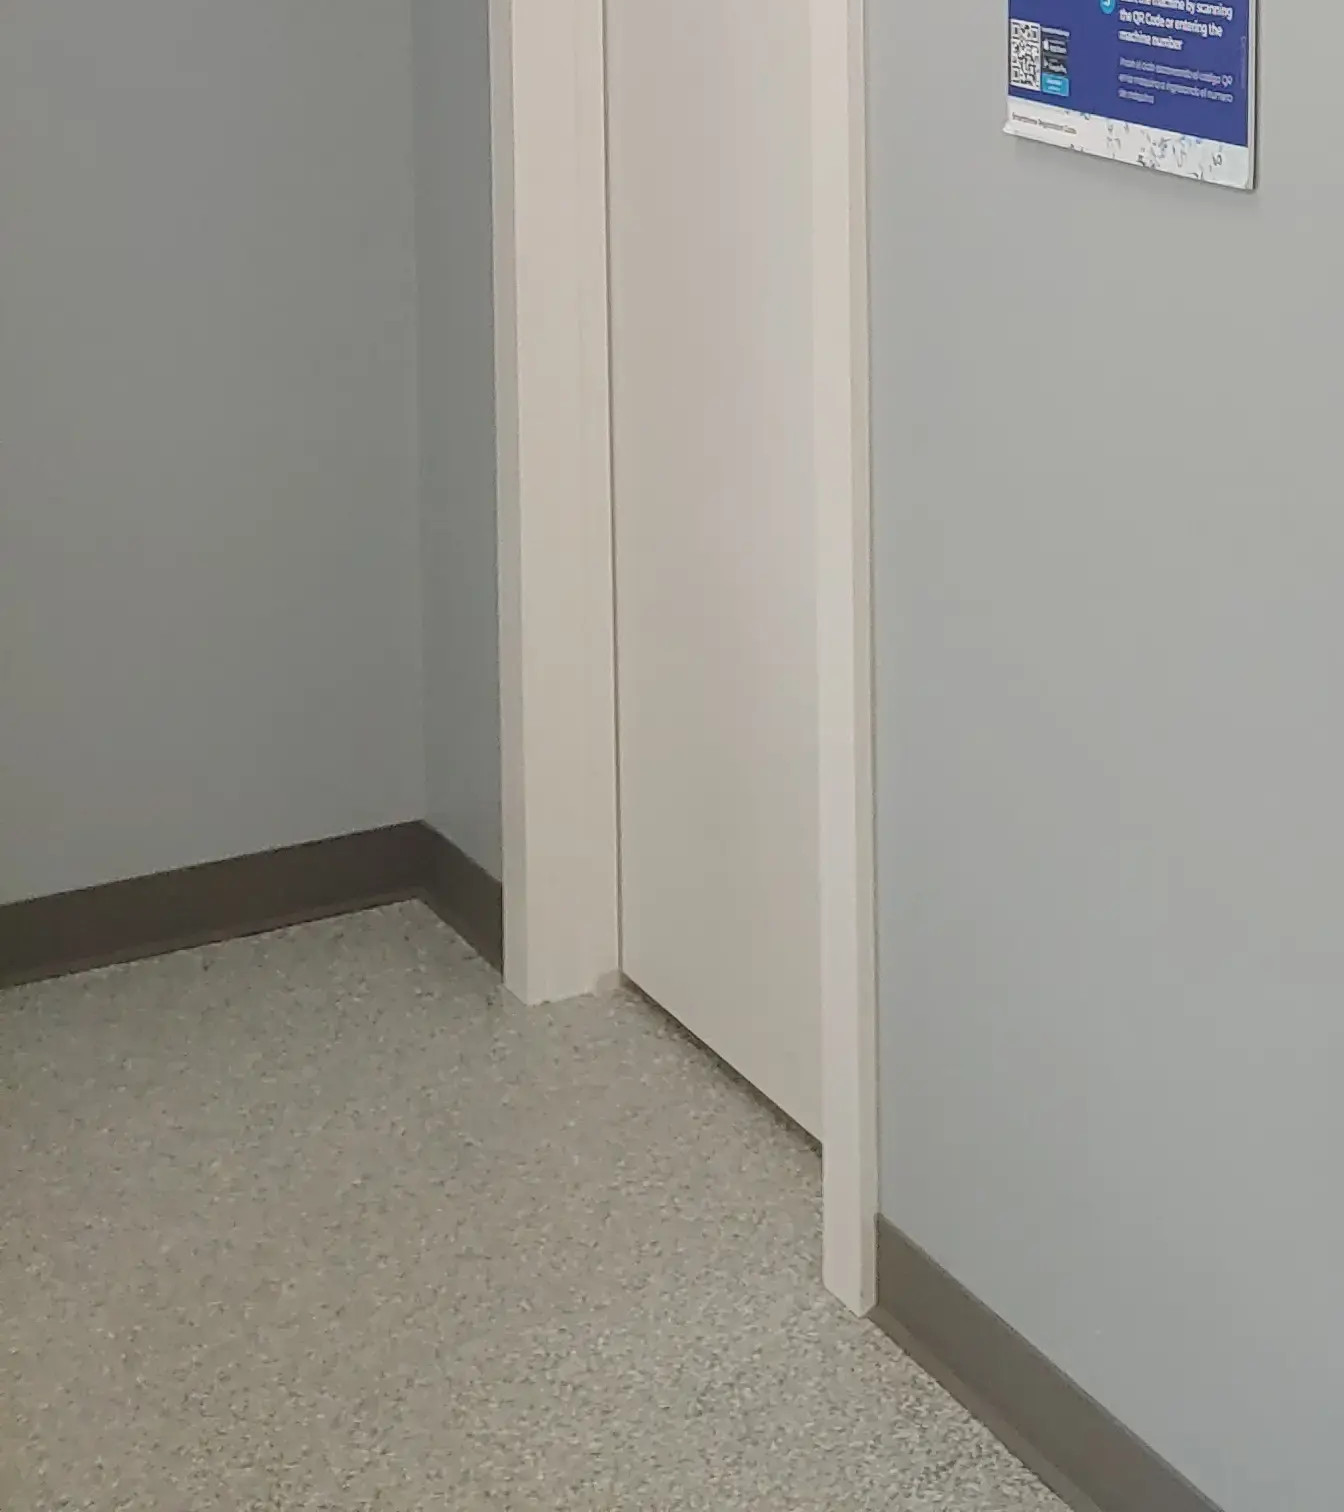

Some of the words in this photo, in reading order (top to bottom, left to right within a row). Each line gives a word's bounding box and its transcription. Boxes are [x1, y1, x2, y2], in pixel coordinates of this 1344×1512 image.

[1120, 8, 1132, 22] the
[1133, 11, 1145, 25] QR
[1146, 13, 1164, 27] Code
[1166, 18, 1174, 28] or
[1175, 19, 1207, 37] entering
[1209, 23, 1223, 37] the
[1196, 2, 1232, 20] scanning
